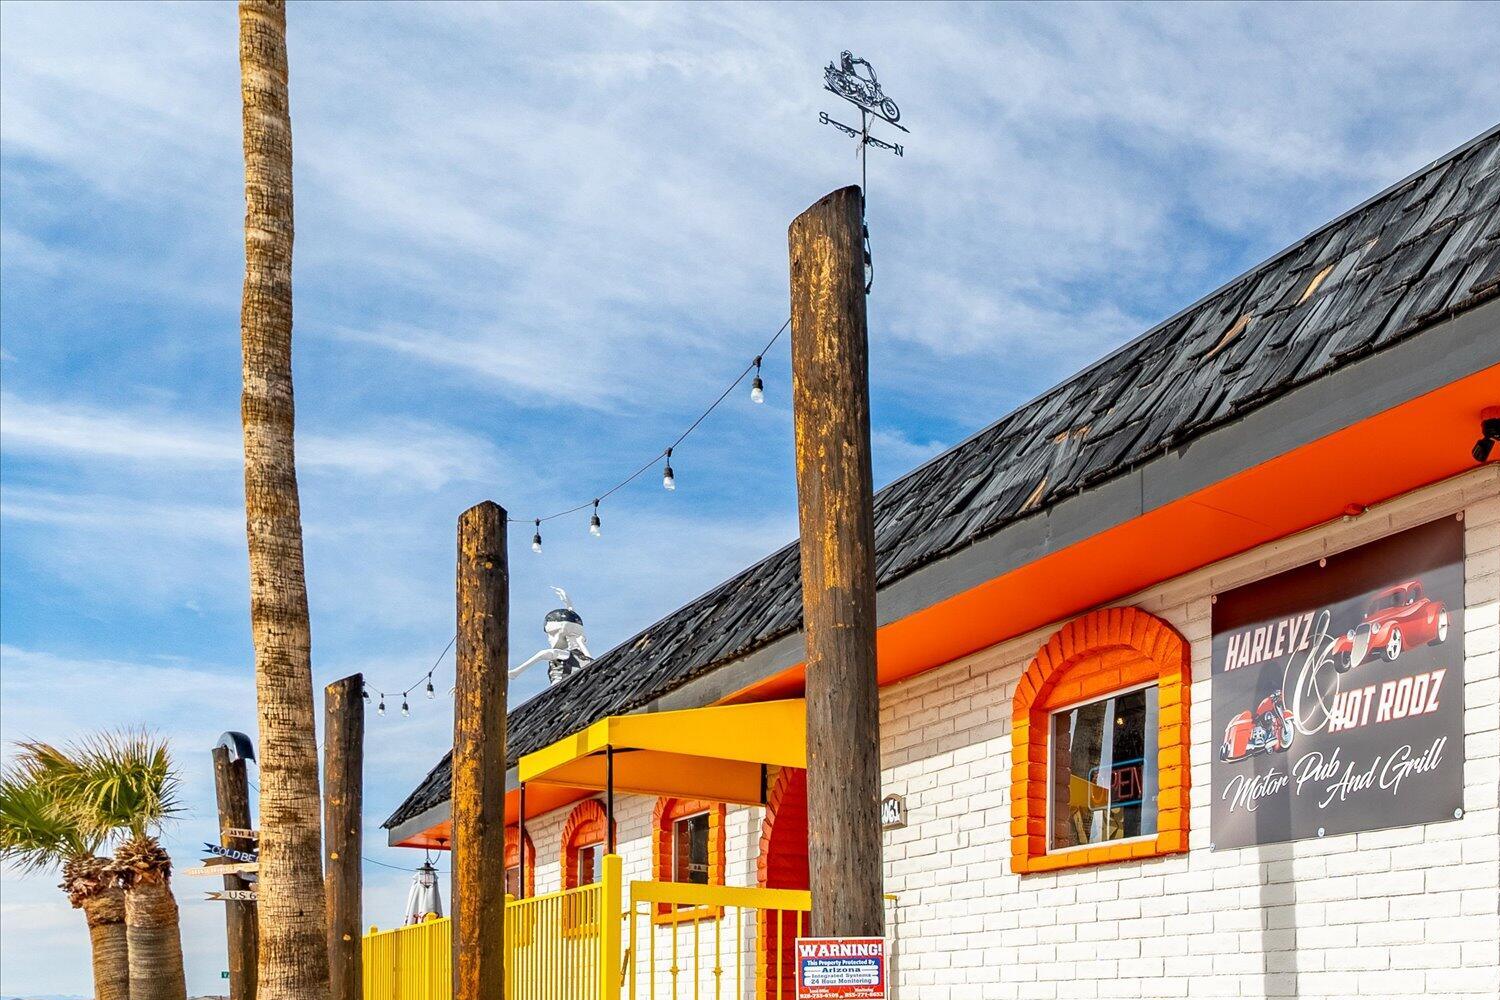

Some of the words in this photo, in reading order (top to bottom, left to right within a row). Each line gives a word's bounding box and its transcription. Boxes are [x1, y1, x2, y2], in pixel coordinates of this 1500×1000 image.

[1224, 610, 1316, 672] HARLEYZ
[1328, 685, 1375, 734] HOT
[1377, 668, 1447, 723] RODZ
[1222, 768, 1289, 813] Motor
[1293, 747, 1340, 796] Pub
[1319, 757, 1377, 808] And
[1380, 736, 1447, 796] Grill
[212, 845, 240, 860] COLD
[798, 944, 883, 957] WARNING!
